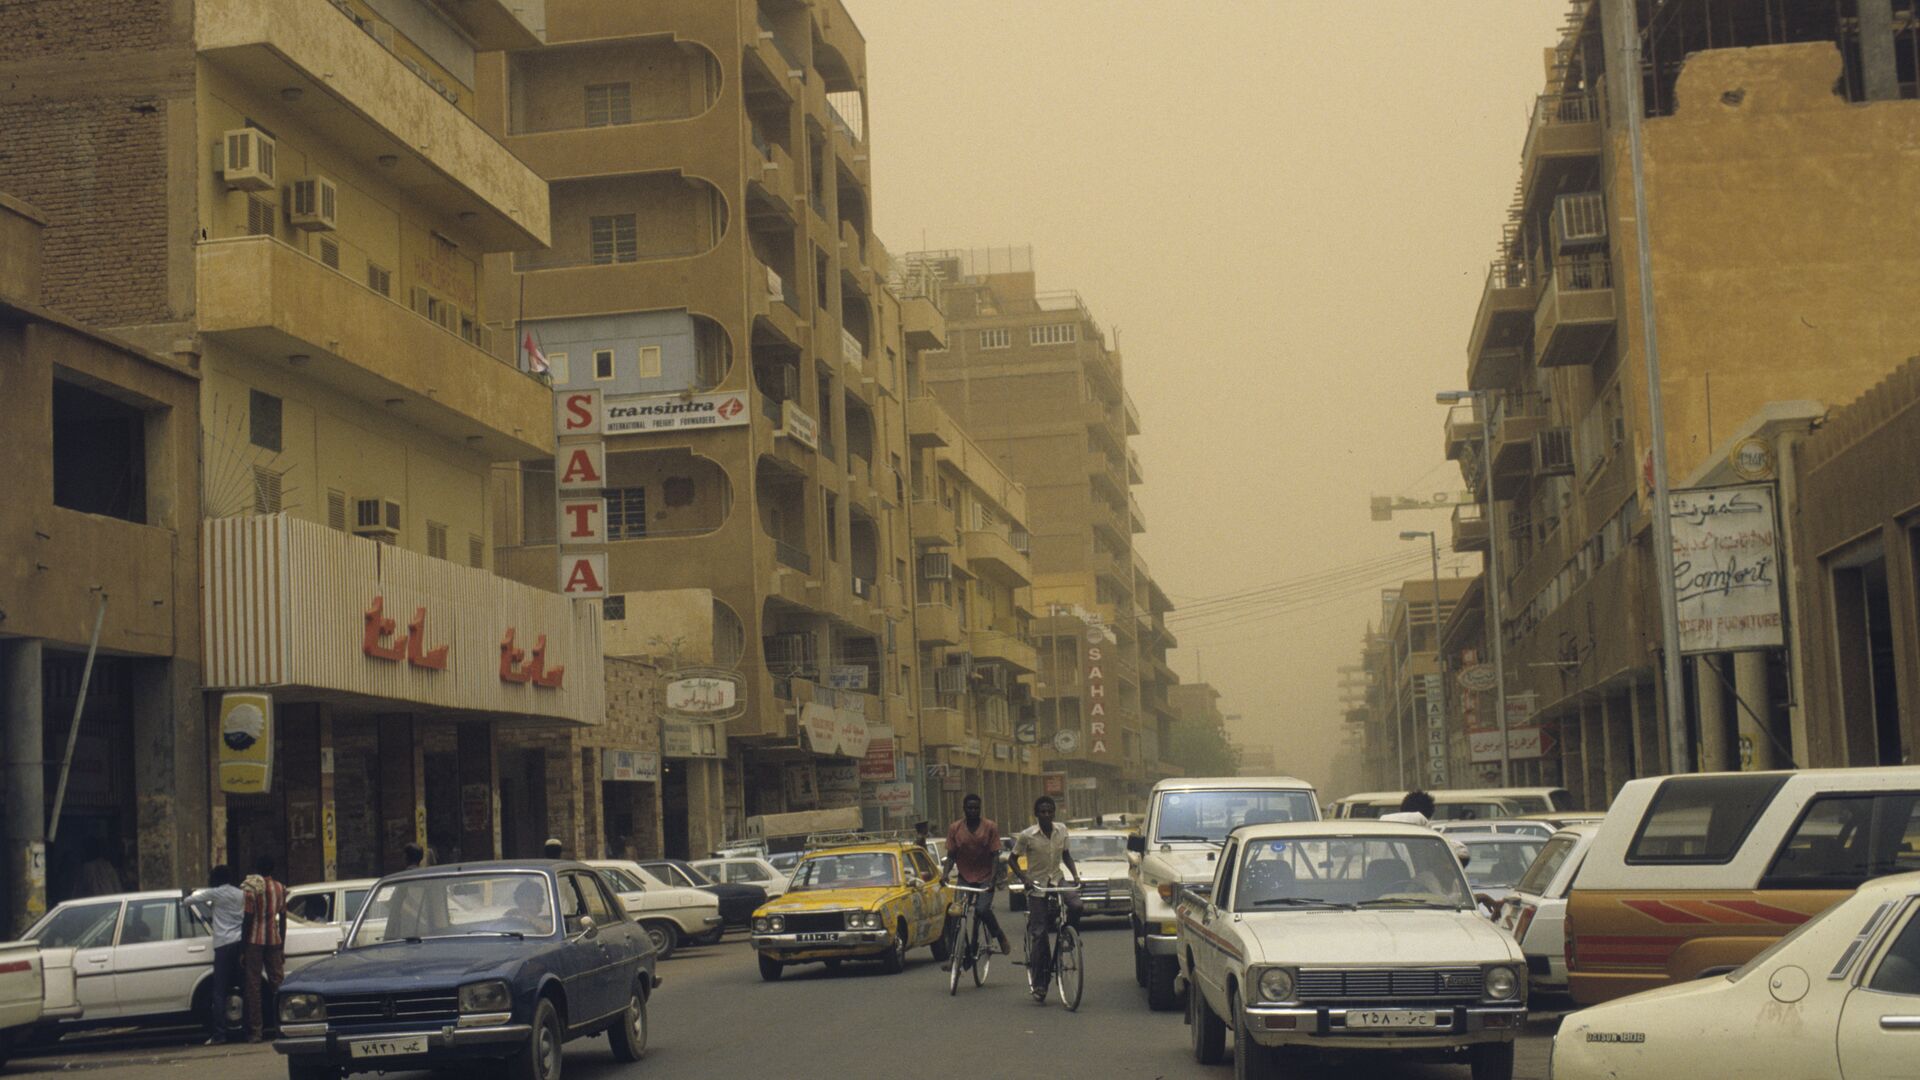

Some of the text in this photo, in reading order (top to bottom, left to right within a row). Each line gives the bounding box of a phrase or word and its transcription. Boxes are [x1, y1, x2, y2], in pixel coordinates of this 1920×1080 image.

[607, 415, 716, 431] INTERNATIONAL FREIGHT FORWARDERS
[608, 400, 715, 418] transintra
[561, 393, 604, 594] SATA
[1673, 555, 1773, 597] Comfort
[1087, 647, 1107, 754] SAHARA
[1429, 703, 1444, 784] AFRICA
